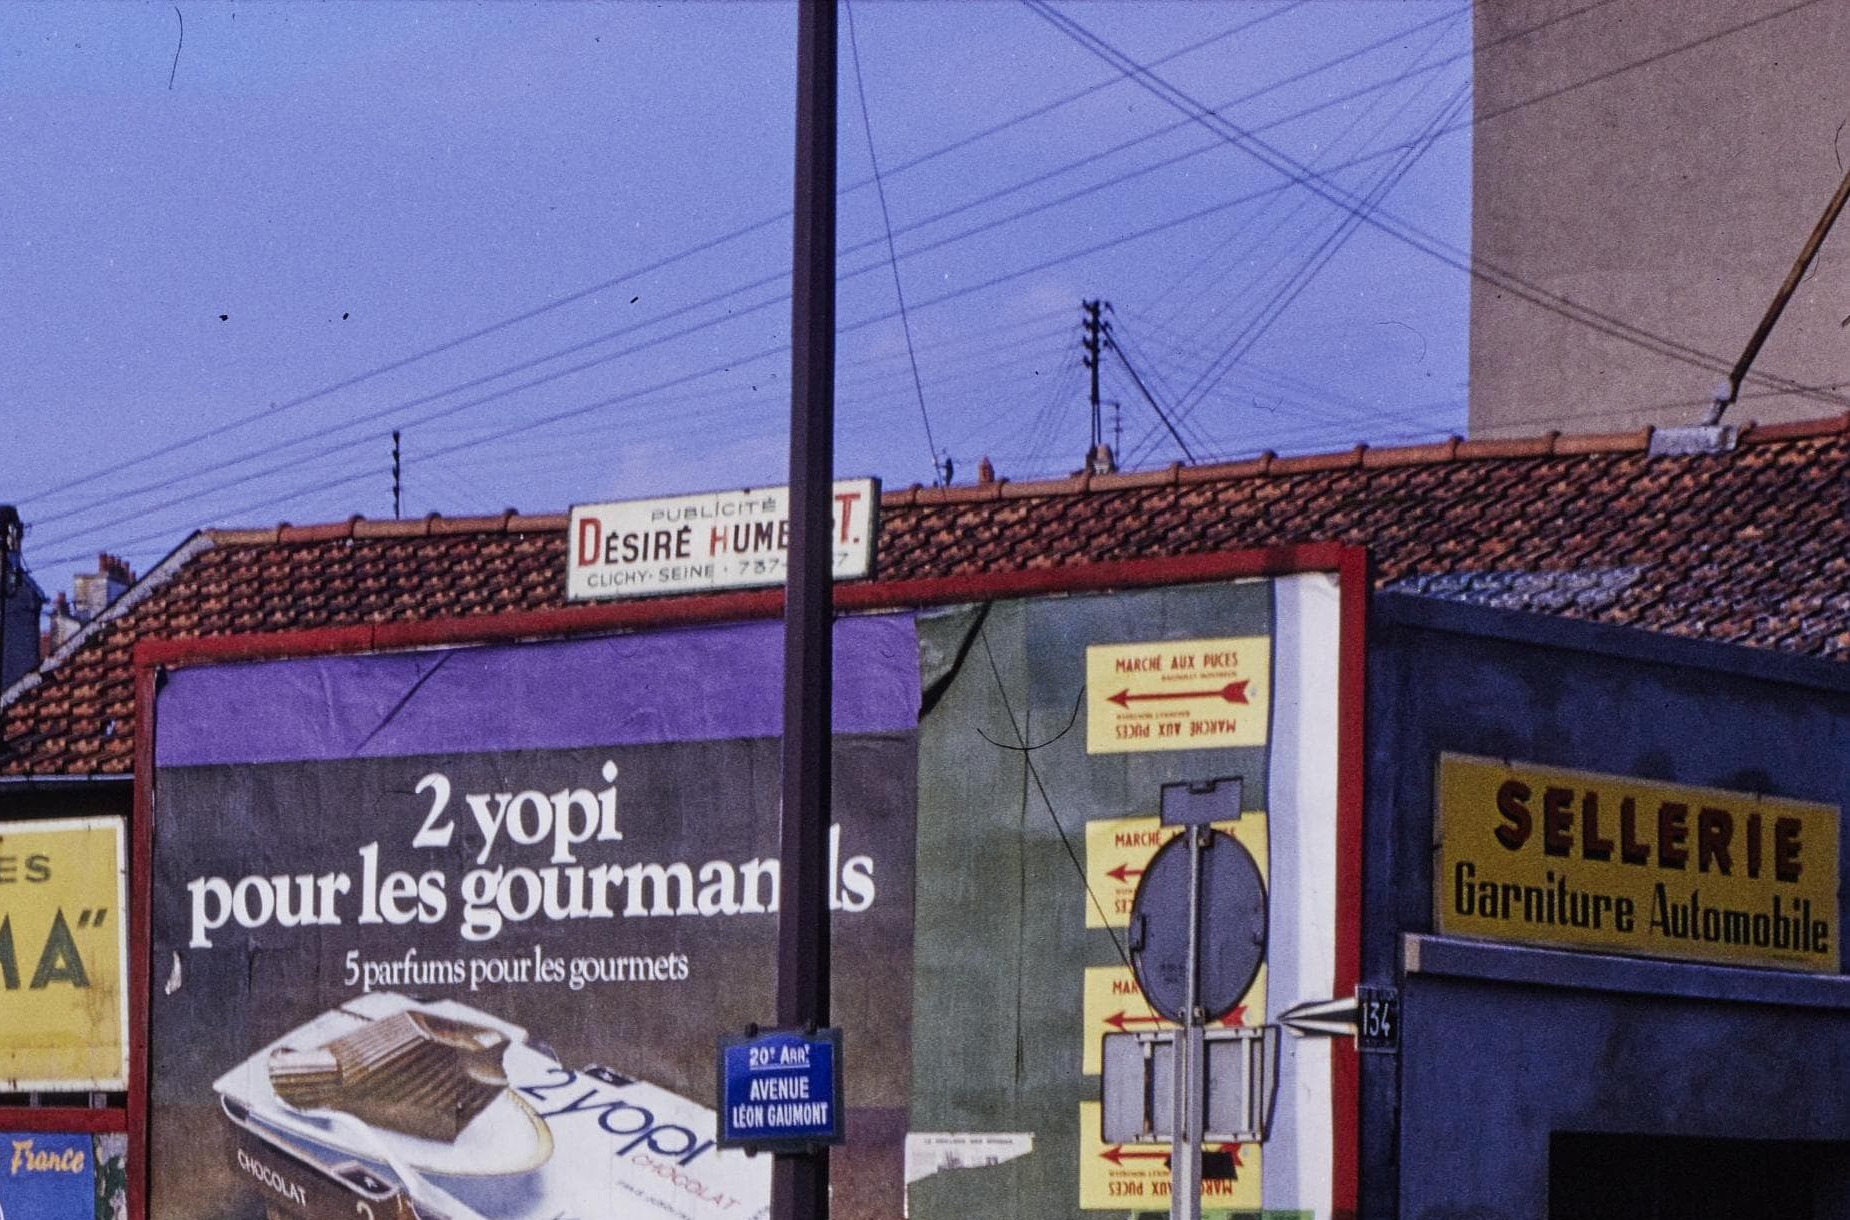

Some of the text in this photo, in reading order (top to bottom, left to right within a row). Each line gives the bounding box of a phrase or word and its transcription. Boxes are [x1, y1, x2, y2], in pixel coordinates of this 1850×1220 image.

[651, 496, 777, 523] PUBLICITÉ
[577, 517, 693, 567] DÉSIRÉ
[1116, 651, 1238, 673] MARCHÉ AUX PUCES
[412, 760, 623, 864] 2 yopi
[1493, 779, 1803, 883] SELLERIE
[188, 823, 875, 948] pour les gourmans
[1455, 861, 1829, 954] Garniture Automobile
[344, 946, 689, 991] 5 parfums pour les gourmets
[750, 1077, 809, 1101] AVENUE
[732, 1102, 828, 1128] LÉON GAUMONT
[11, 1139, 85, 1175] France
[237, 1148, 307, 1207] CHOCOLAT
